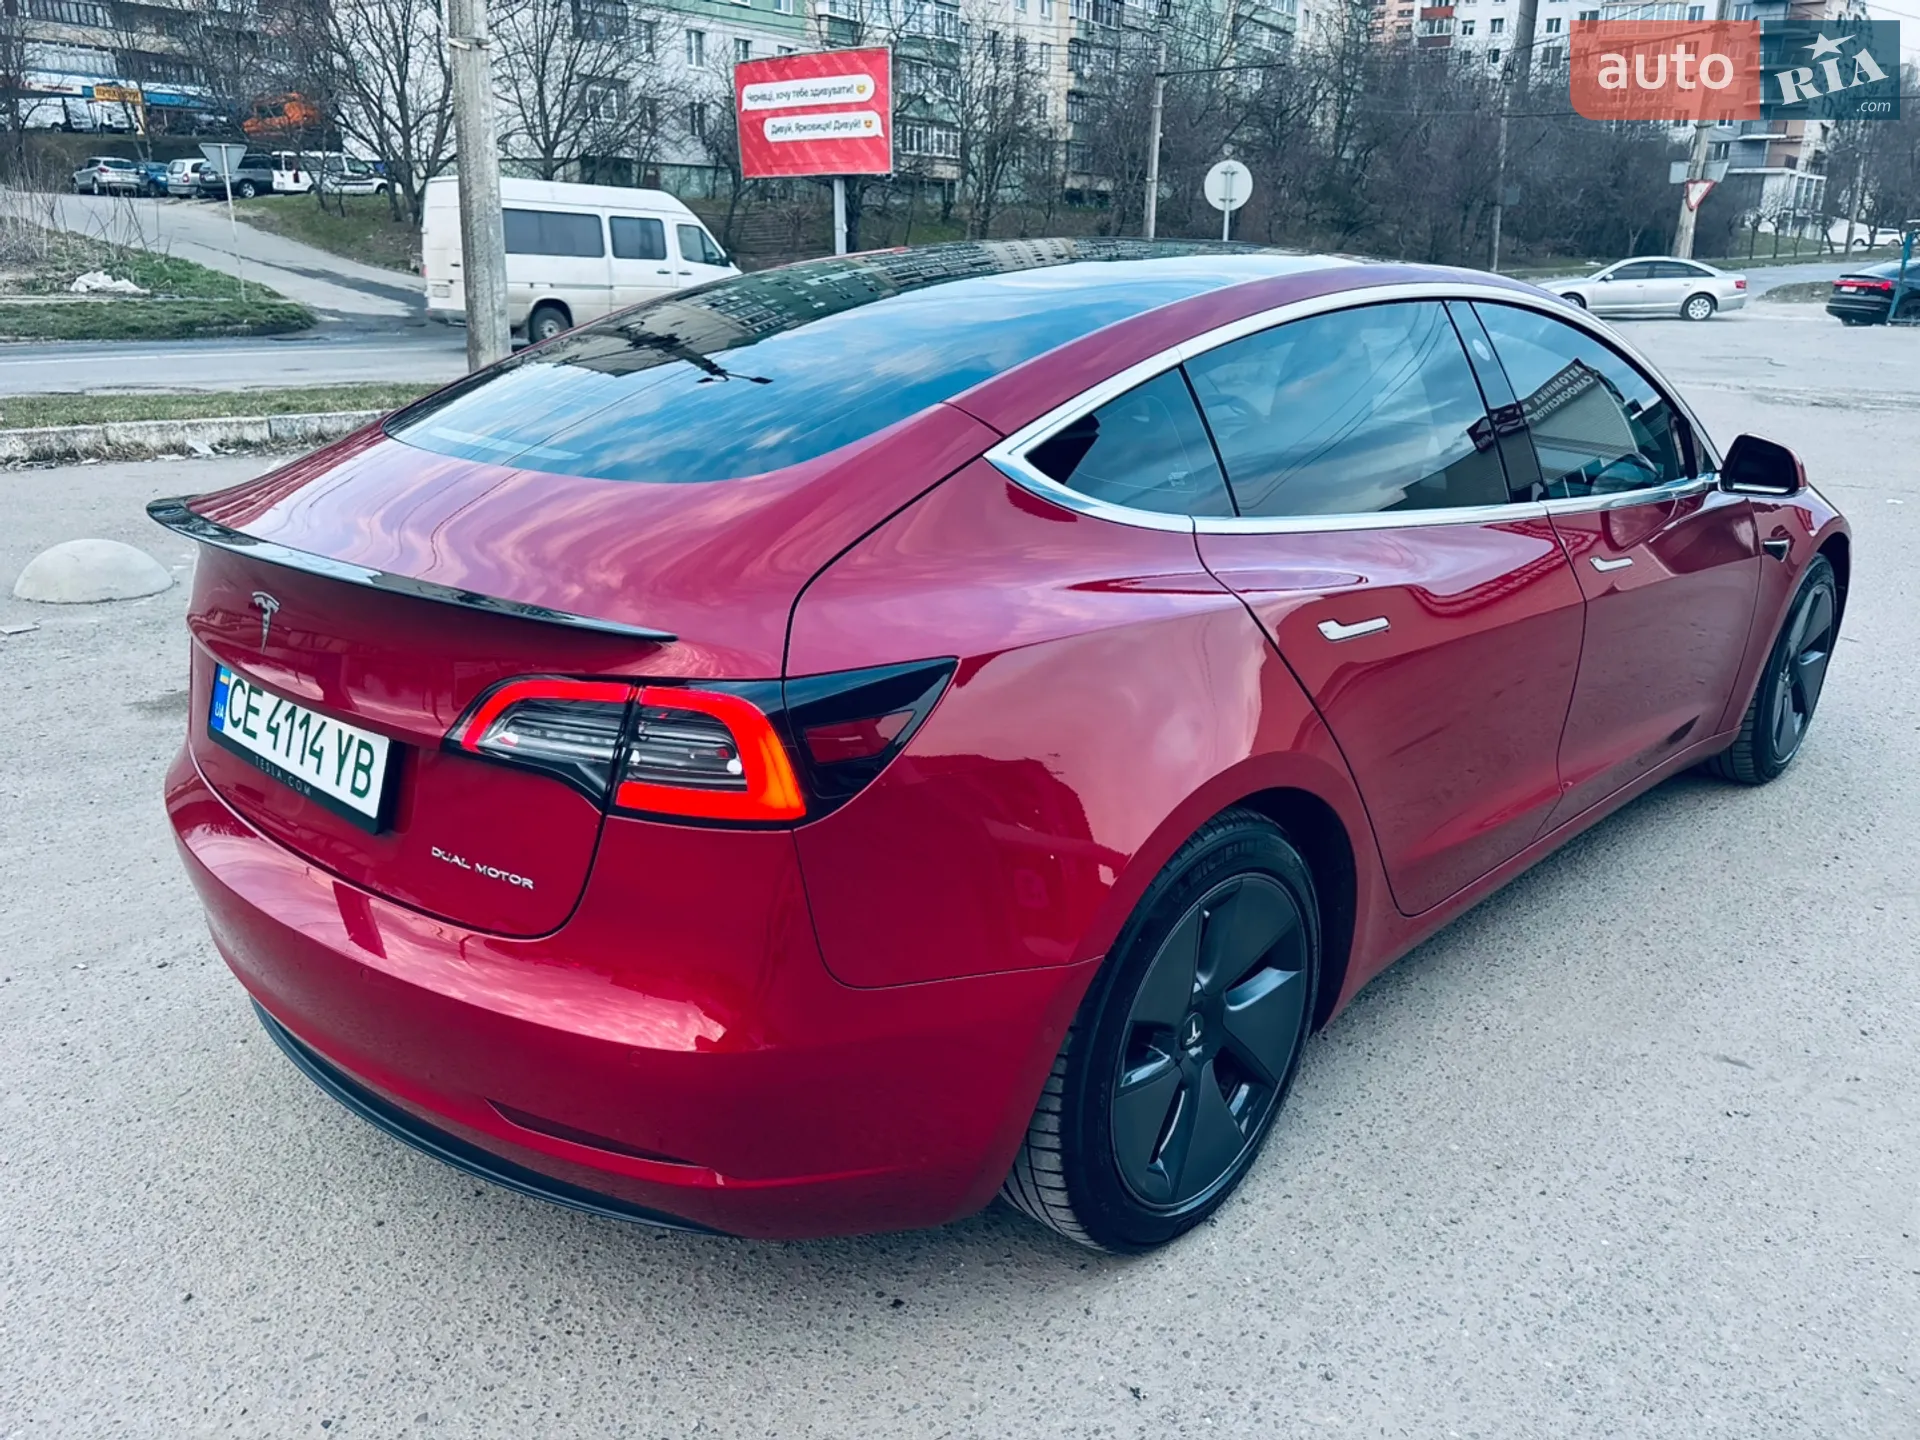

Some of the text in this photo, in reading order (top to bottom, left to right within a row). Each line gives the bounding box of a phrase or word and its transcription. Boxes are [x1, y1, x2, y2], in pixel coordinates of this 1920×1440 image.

[776, 91, 791, 101] хочу
[792, 87, 809, 98] тебе
[810, 84, 854, 98] здивувати!
[833, 119, 861, 132] Дивуй!
[229, 679, 374, 798] CE 4114 YB
[255, 755, 312, 797] TESLA.COM
[431, 846, 534, 890] DUAL MOTOR
